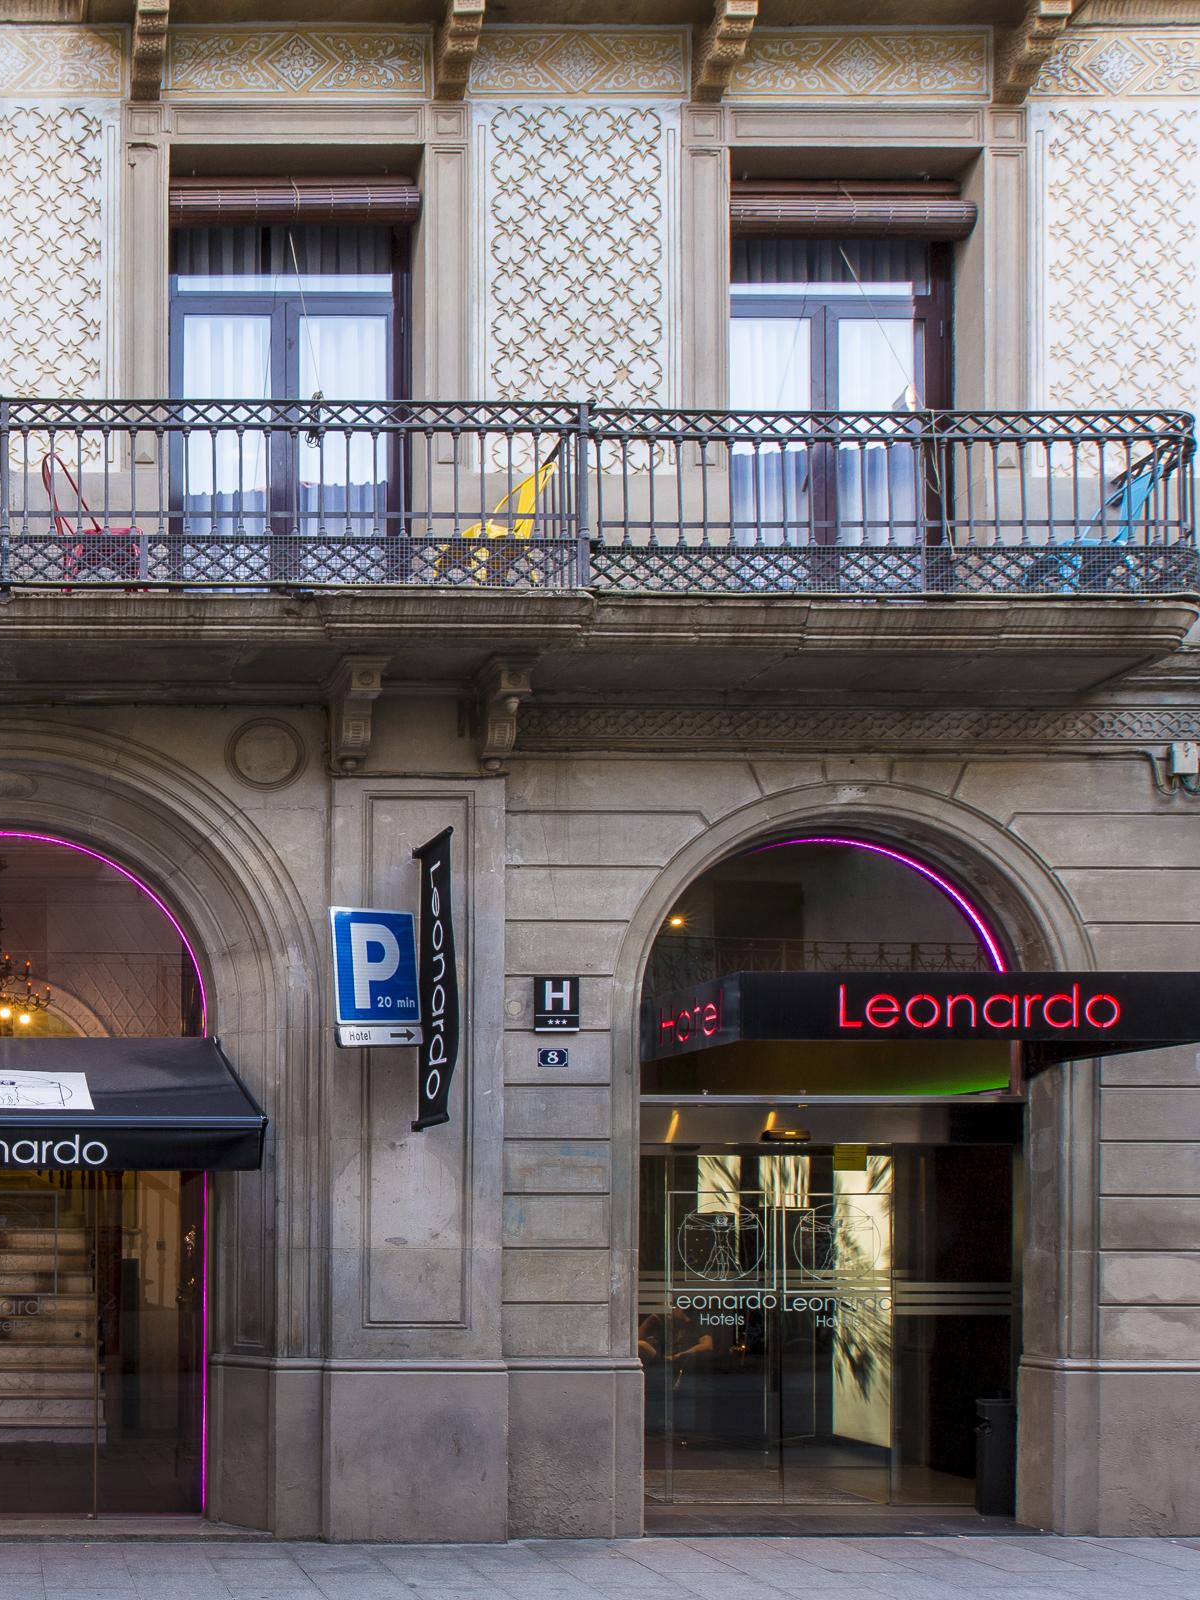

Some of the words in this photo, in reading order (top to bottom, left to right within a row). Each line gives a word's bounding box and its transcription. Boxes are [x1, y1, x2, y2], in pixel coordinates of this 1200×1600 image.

[350, 922, 401, 1010] P
[426, 860, 448, 1100] Leonardo
[377, 995, 392, 1008] 20
[397, 997, 416, 1009] min
[545, 980, 570, 1011] H
[838, 982, 1121, 1029] Leonardo
[659, 989, 724, 1048] Hotel
[349, 1030, 372, 1041] Hotel
[547, 1050, 559, 1064] 8
[666, 1291, 778, 1310] eonardo
[782, 1293, 892, 1312] Leondo
[700, 1312, 745, 1326] Hotels
